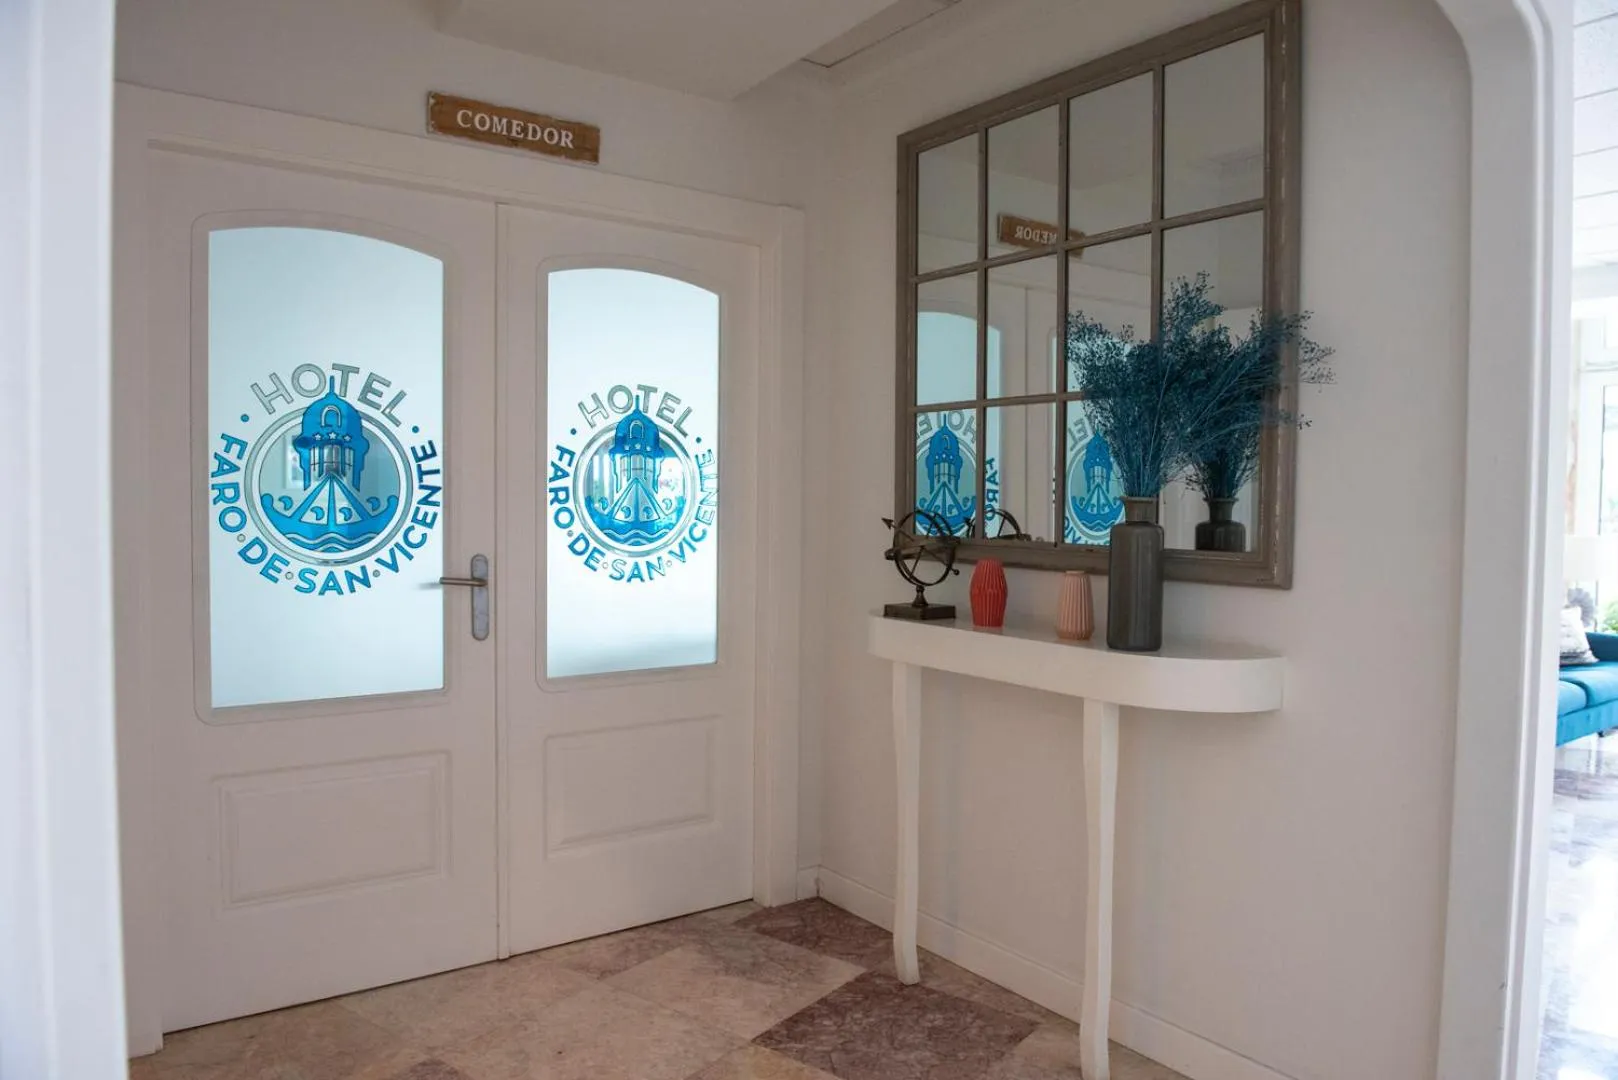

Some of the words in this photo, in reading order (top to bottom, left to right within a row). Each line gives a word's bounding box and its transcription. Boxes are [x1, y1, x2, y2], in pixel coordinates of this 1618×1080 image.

[456, 109, 574, 149] COMEDOR
[250, 363, 407, 428] HOTEL
[577, 384, 693, 438] HOTEL
[210, 433, 248, 533] FARO
[237, 536, 290, 584] DE
[294, 565, 372, 596] SAN
[374, 440, 442, 574] VICENTE
[548, 444, 576, 530] FARO
[567, 532, 606, 572] DE
[608, 556, 666, 583] SAN
[668, 449, 719, 563] VICENTE
